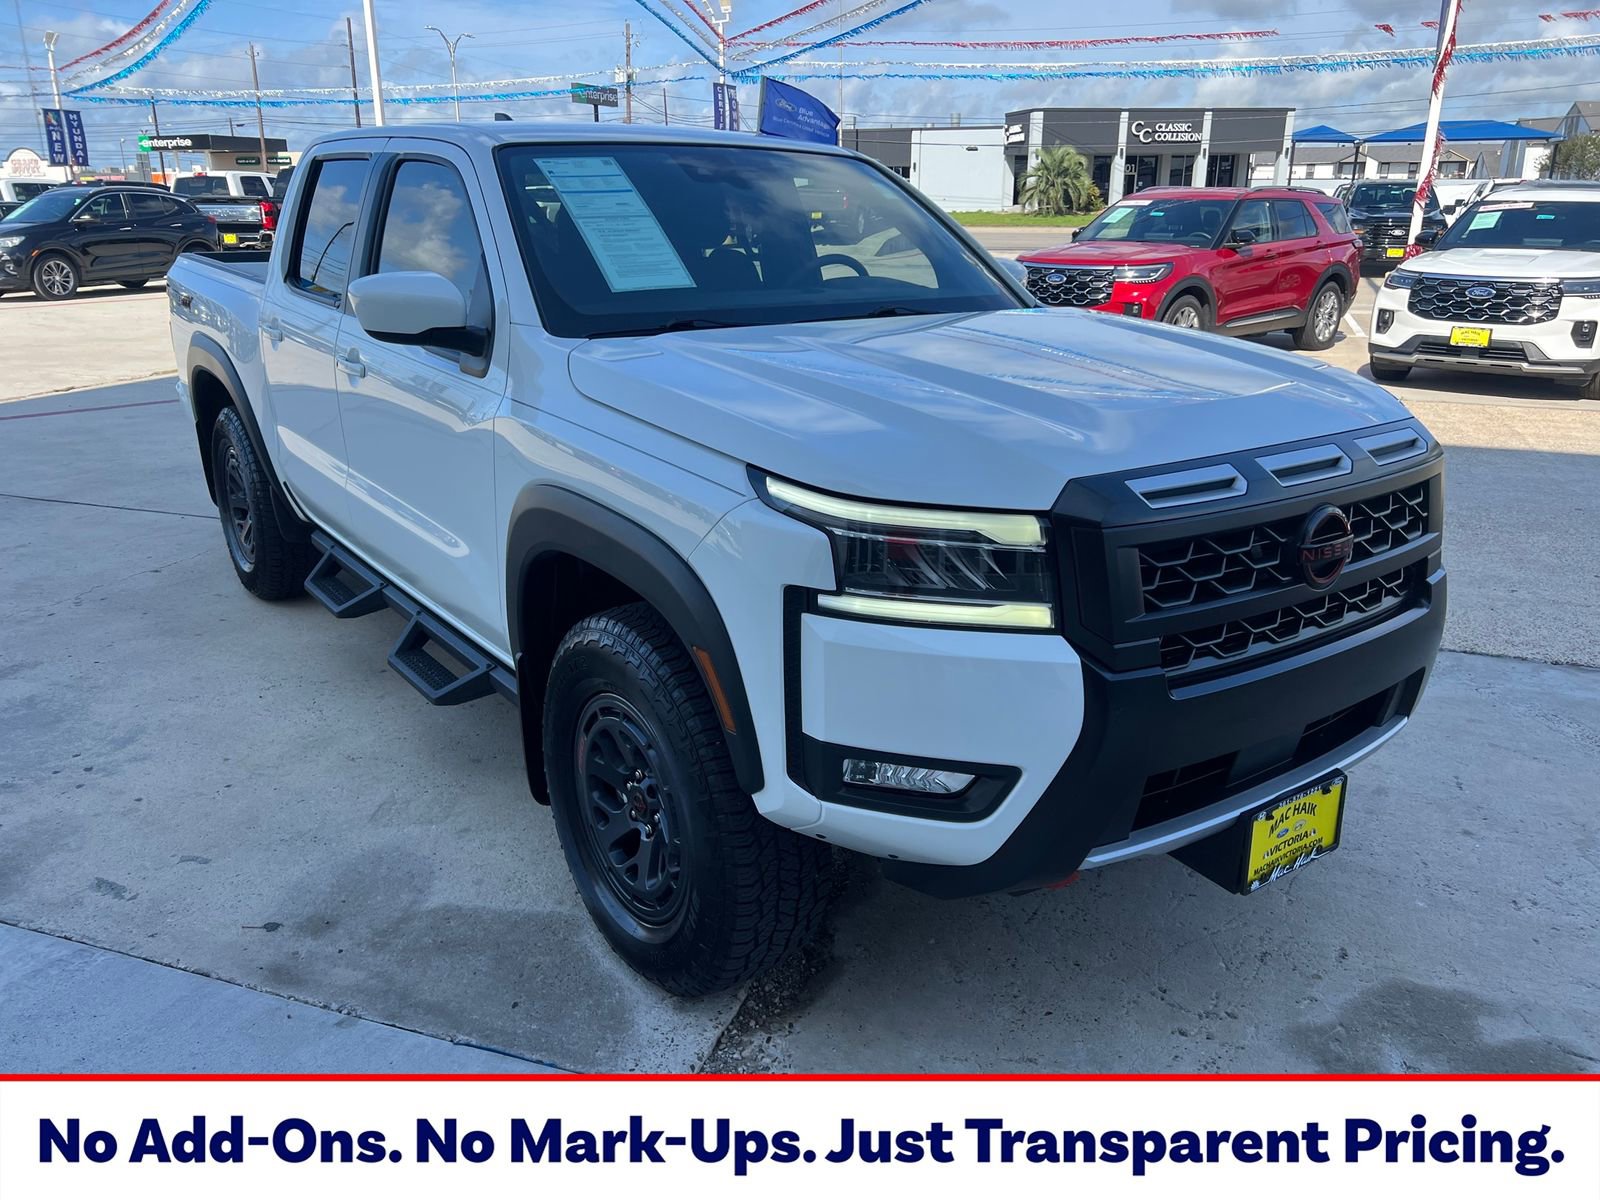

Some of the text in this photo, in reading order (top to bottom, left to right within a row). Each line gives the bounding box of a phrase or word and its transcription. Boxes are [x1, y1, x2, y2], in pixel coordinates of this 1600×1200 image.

[69, 113, 84, 164] HYUNDAI
[1154, 132, 1202, 142] COLLISION
[1155, 123, 1192, 132] CLASSIC
[51, 131, 65, 163] NEW
[141, 137, 192, 149] enterprise
[1268, 807, 1292, 838] MAC
[1292, 802, 1318, 817] HAIK
[1268, 830, 1309, 857] VICTORIA
[1268, 864, 1292, 882] Mac
